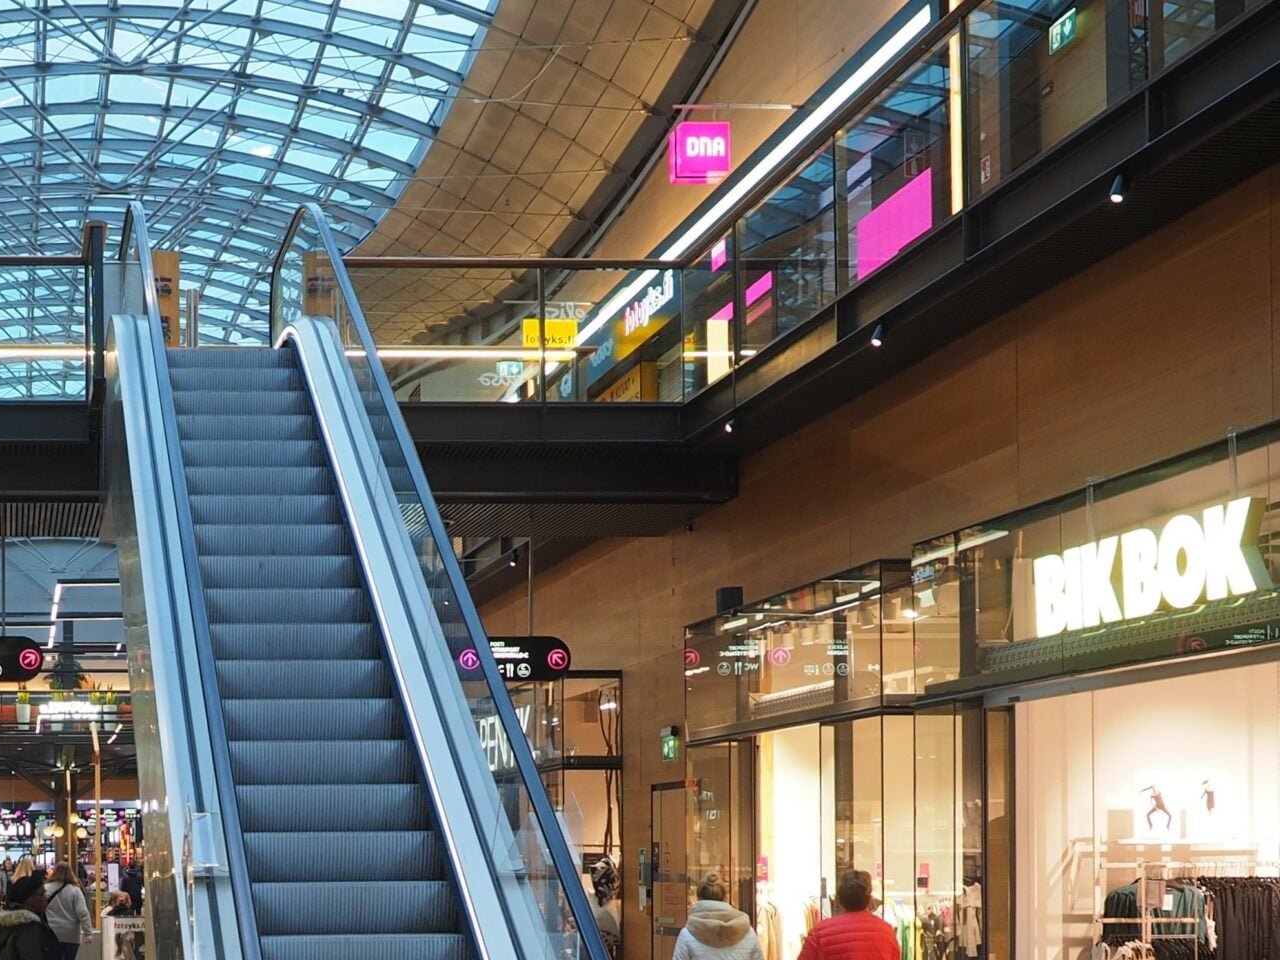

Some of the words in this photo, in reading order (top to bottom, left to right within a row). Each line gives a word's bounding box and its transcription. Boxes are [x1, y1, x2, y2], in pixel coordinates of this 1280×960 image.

[686, 136, 726, 157] DNA
[525, 334, 575, 345] foyks.fi
[1034, 536, 1122, 638] BIK
[1121, 497, 1257, 620] BOK
[114, 922, 145, 930] fotoyks.f
